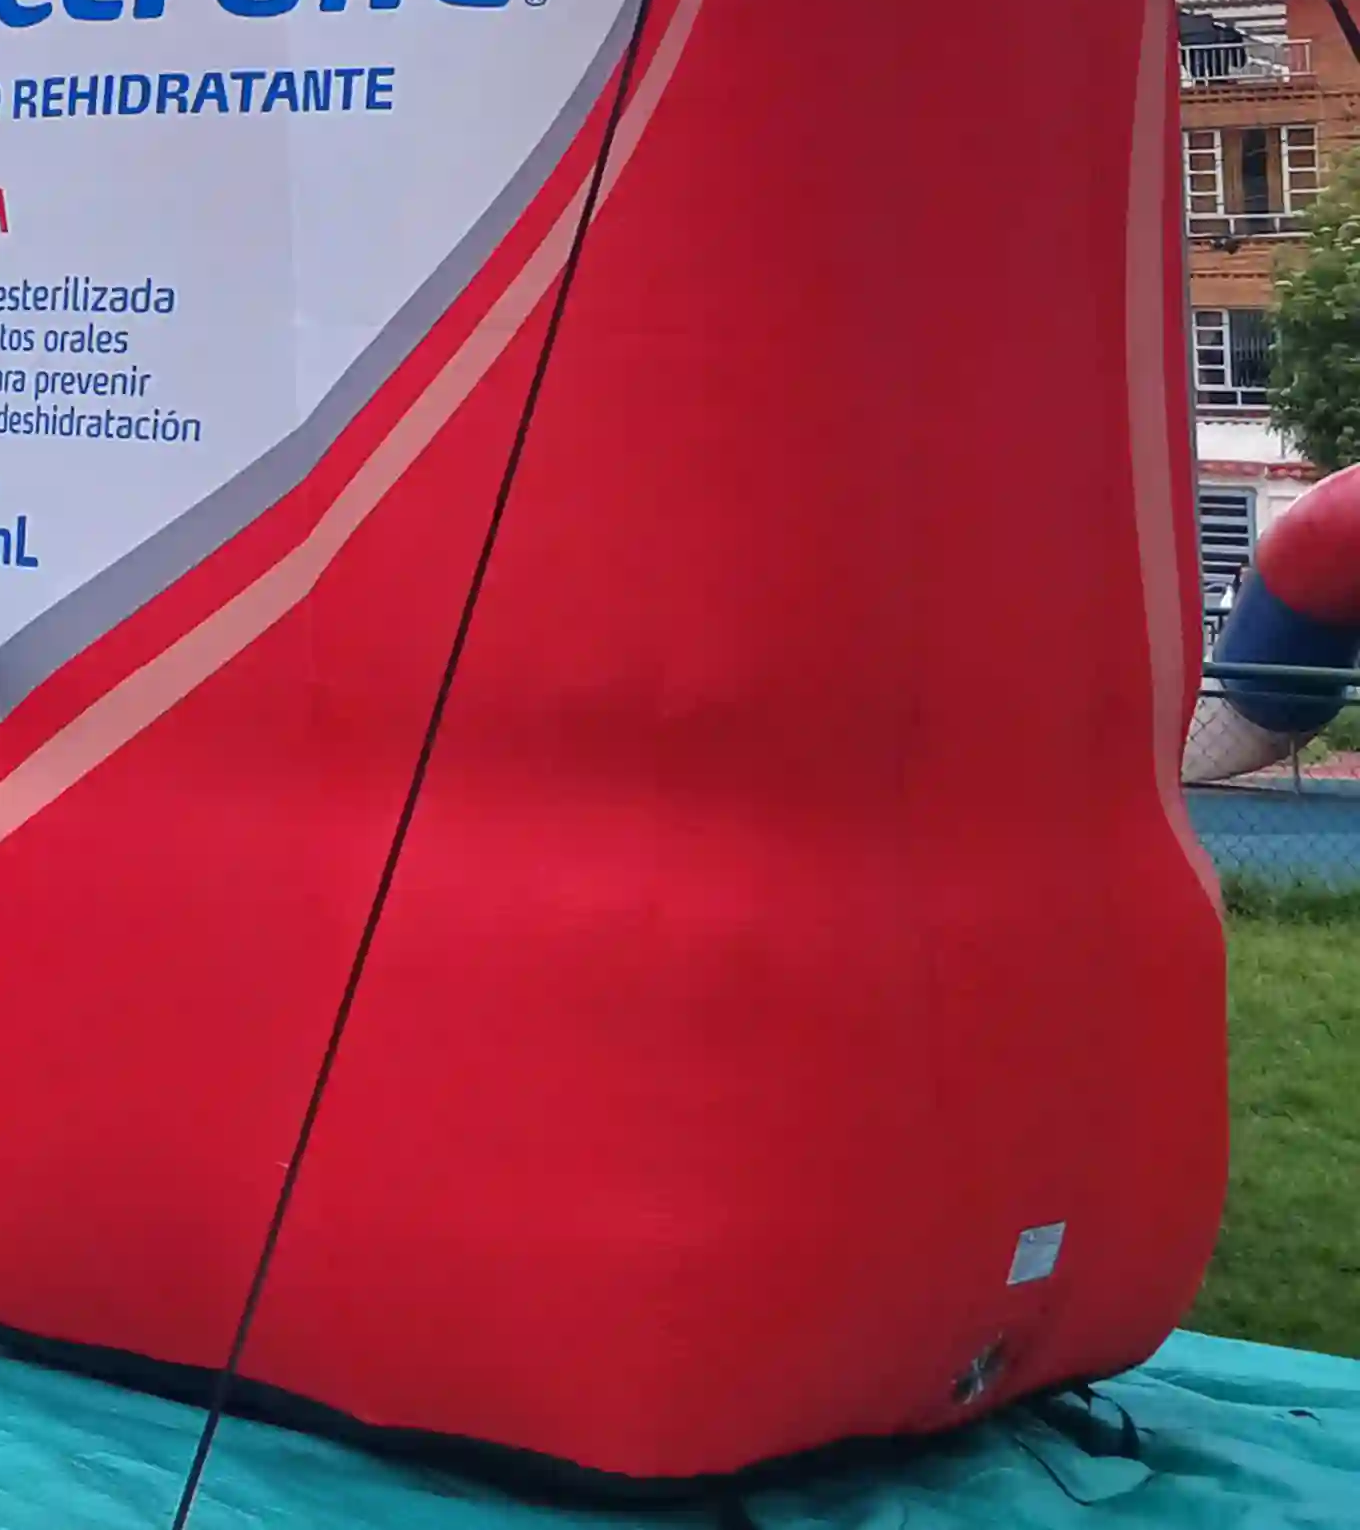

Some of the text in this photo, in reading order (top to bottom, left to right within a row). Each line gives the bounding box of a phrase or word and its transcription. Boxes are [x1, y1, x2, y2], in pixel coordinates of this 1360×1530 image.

[12, 67, 395, 119] REHIDRATANTE
[43, 325, 129, 355] orales
[34, 366, 151, 400] prevenir
